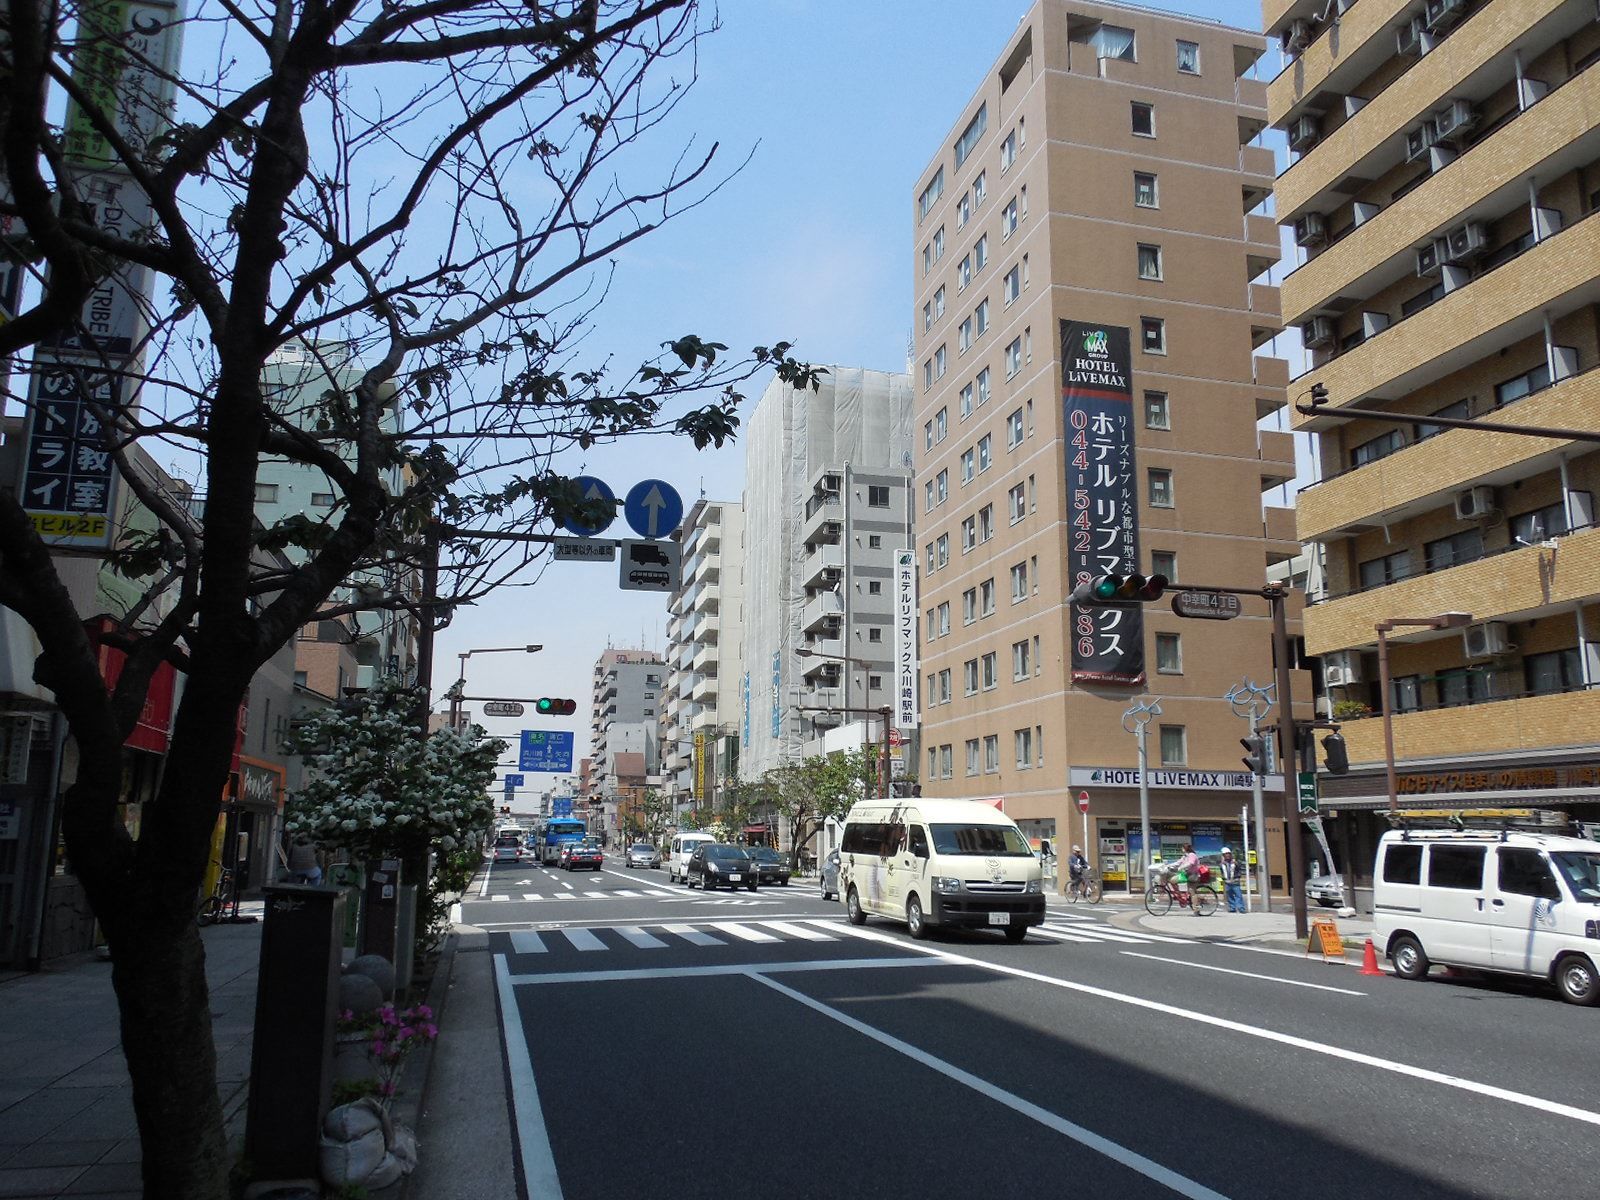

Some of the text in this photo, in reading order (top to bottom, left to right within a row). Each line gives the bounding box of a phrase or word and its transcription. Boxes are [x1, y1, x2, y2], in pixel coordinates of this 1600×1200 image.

[1088, 338, 1108, 353] MAX
[1075, 358, 1119, 373] HOTEL
[1069, 370, 1127, 388] LiVEMAX
[32, 371, 75, 505] のトライ
[1070, 409, 1095, 658] 044-542-886
[1091, 411, 1125, 657] ホテルリブマクス
[1181, 593, 1237, 609] 中幸町4丁目
[901, 570, 913, 724] ホテルリブマックス川崎駅前
[1154, 772, 1219, 787] LiVEMAX
